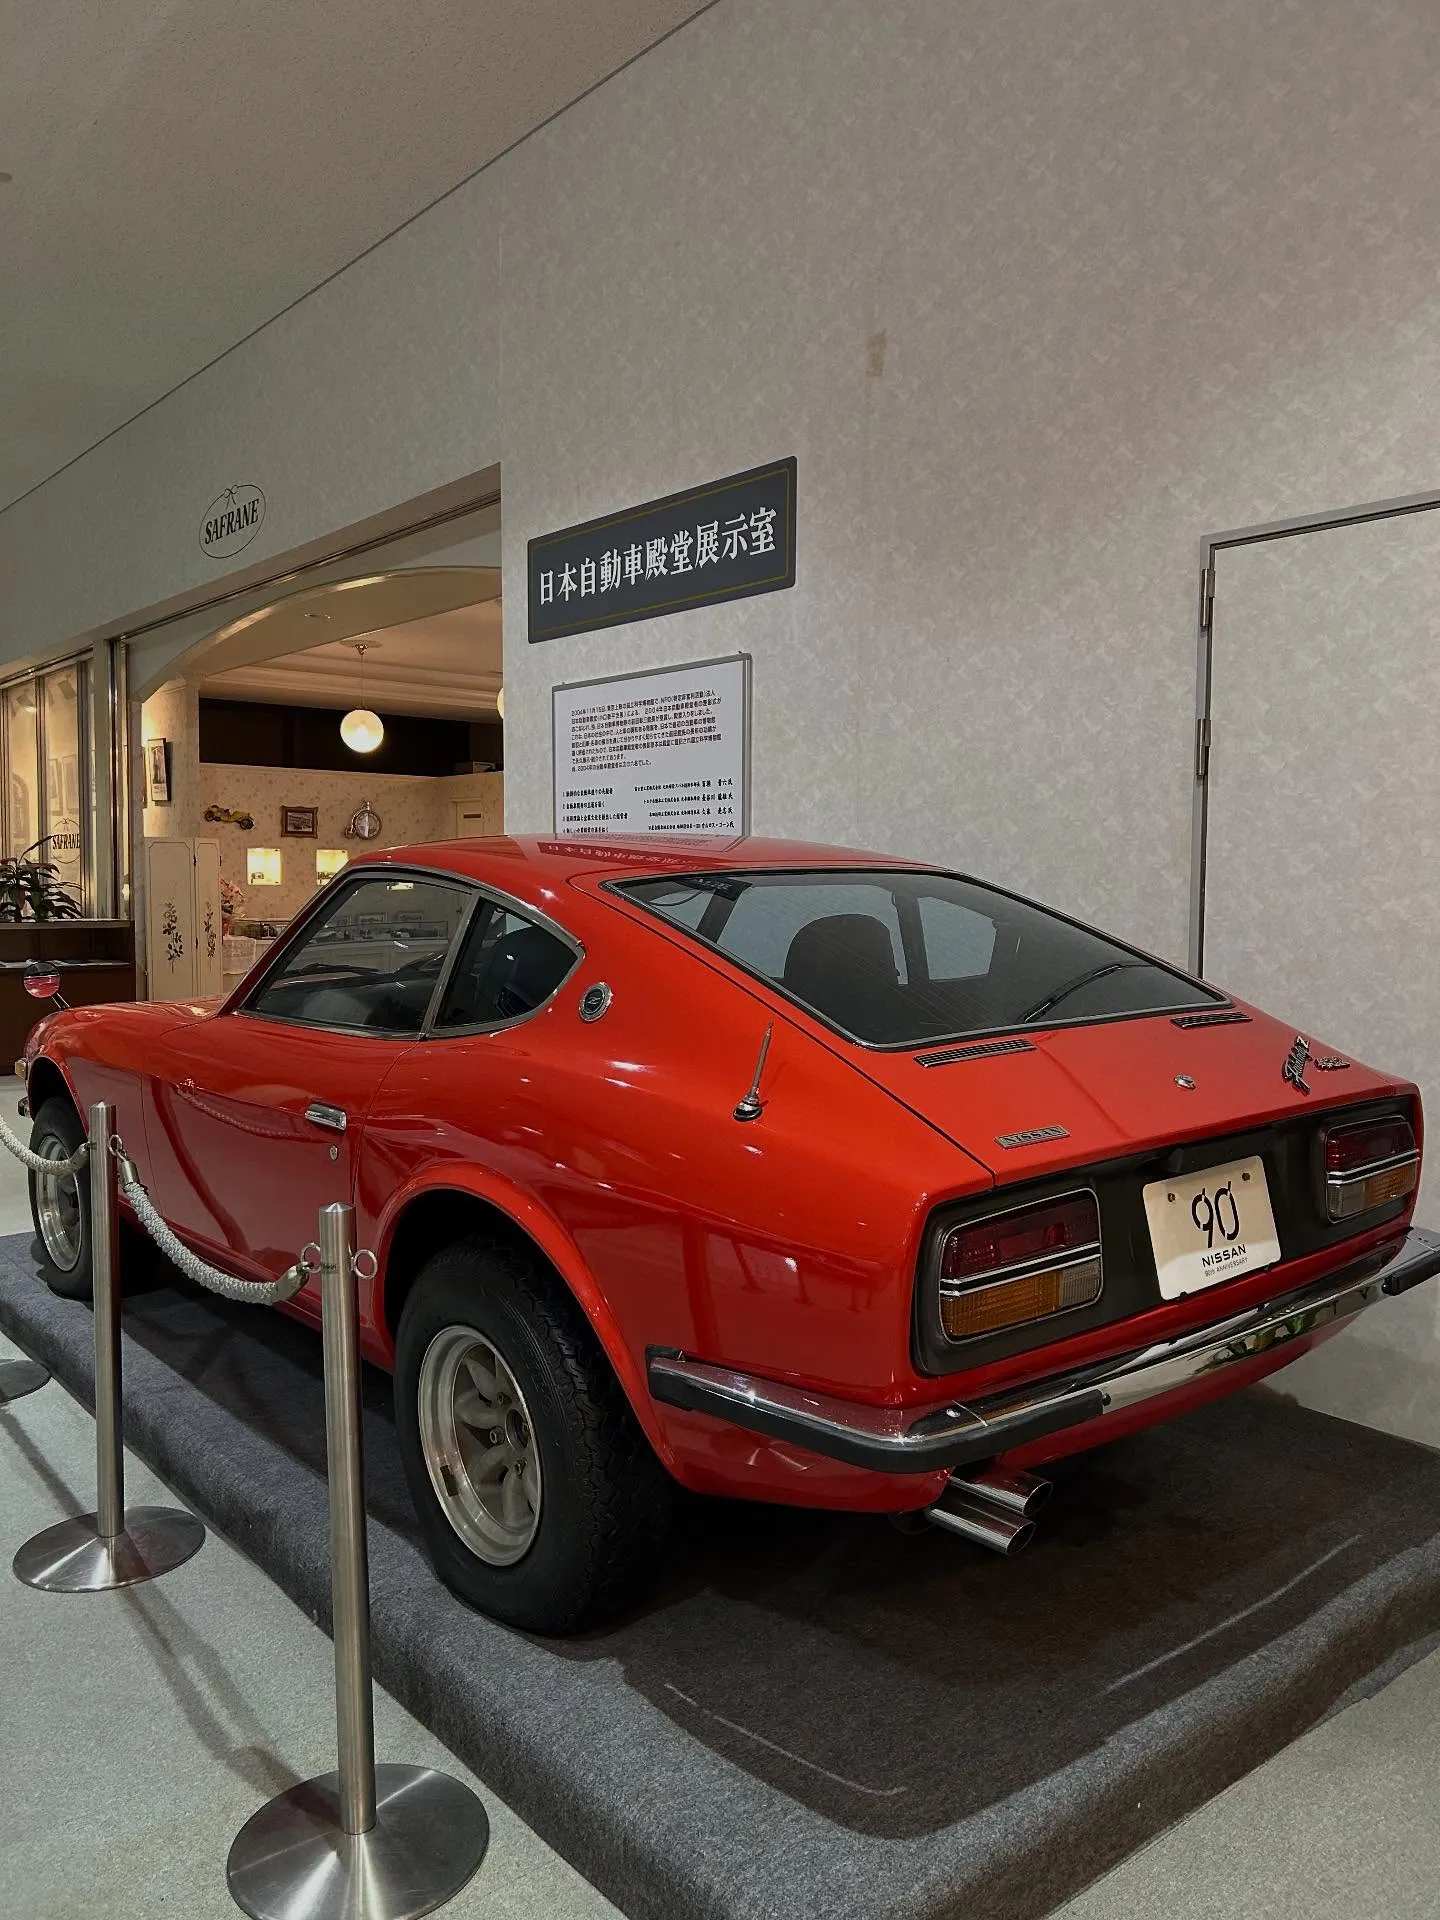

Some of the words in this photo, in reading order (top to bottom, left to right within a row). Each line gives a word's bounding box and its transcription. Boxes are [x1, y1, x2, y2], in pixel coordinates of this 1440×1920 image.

[204, 498, 260, 544] SAFRANE
[540, 506, 777, 606] 日本自動車殿堂展示室
[1191, 1180, 1240, 1248] 90
[1201, 1243, 1247, 1268] NISSAN
